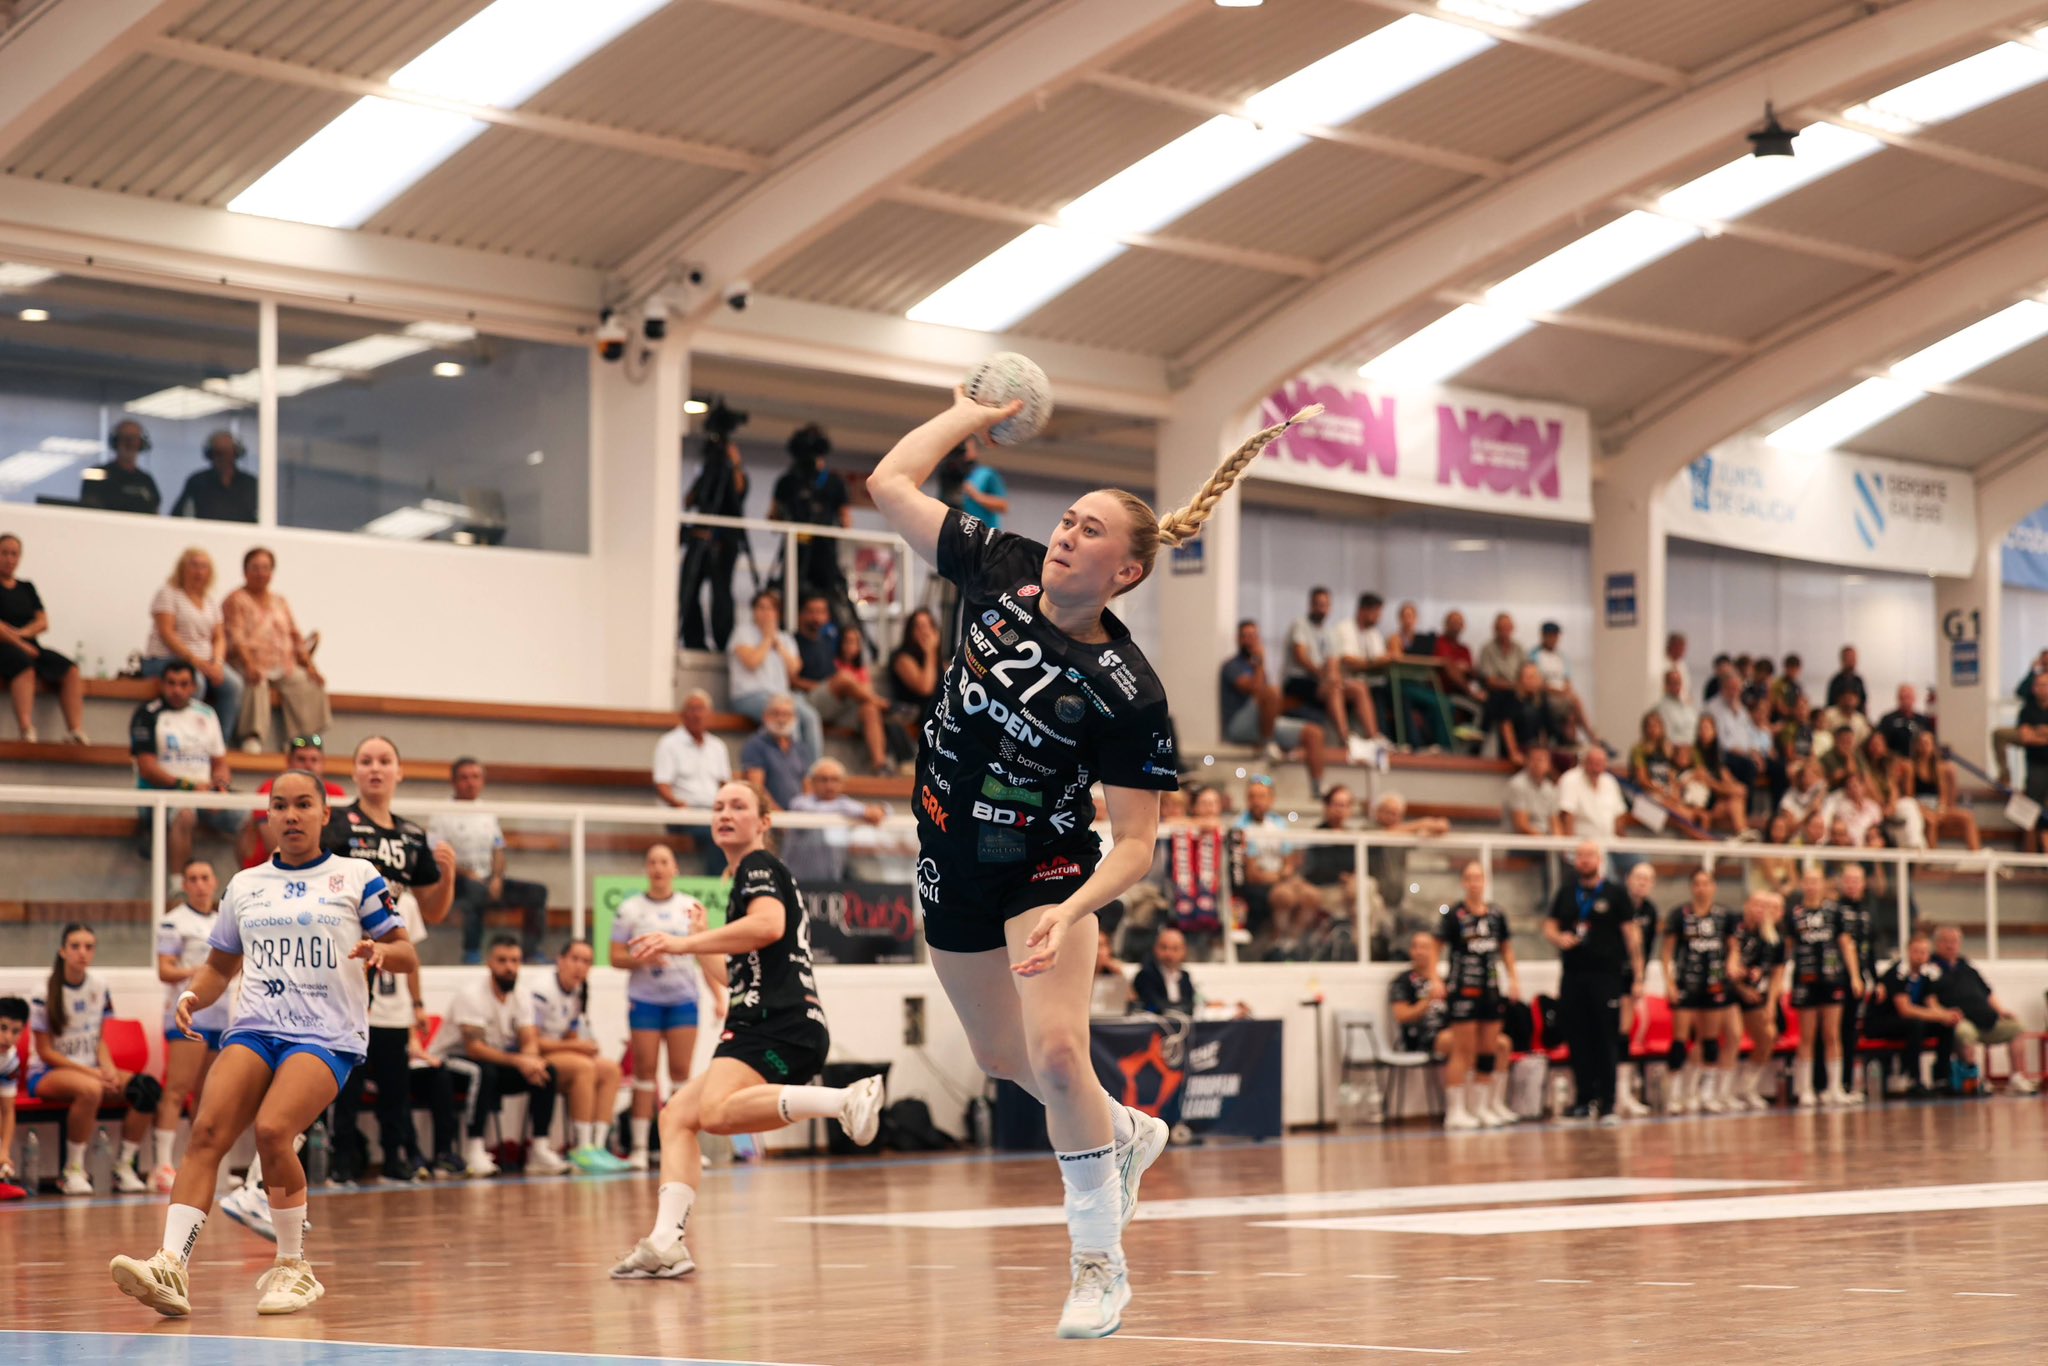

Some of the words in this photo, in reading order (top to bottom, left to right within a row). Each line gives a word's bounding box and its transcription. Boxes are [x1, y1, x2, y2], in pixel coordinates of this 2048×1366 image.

[998, 592, 1033, 625] Kempa
[1943, 609, 1981, 644] G1
[990, 640, 1062, 705] 21
[1120, 663, 1137, 683] Svensk
[958, 665, 1043, 748] BODEN
[1020, 707, 1077, 747] Handelsbanken
[377, 837, 406, 870] 45
[1032, 865, 1078, 880] KVANTUM
[284, 881, 306, 899] 38
[252, 936, 337, 970] ORPAGU
